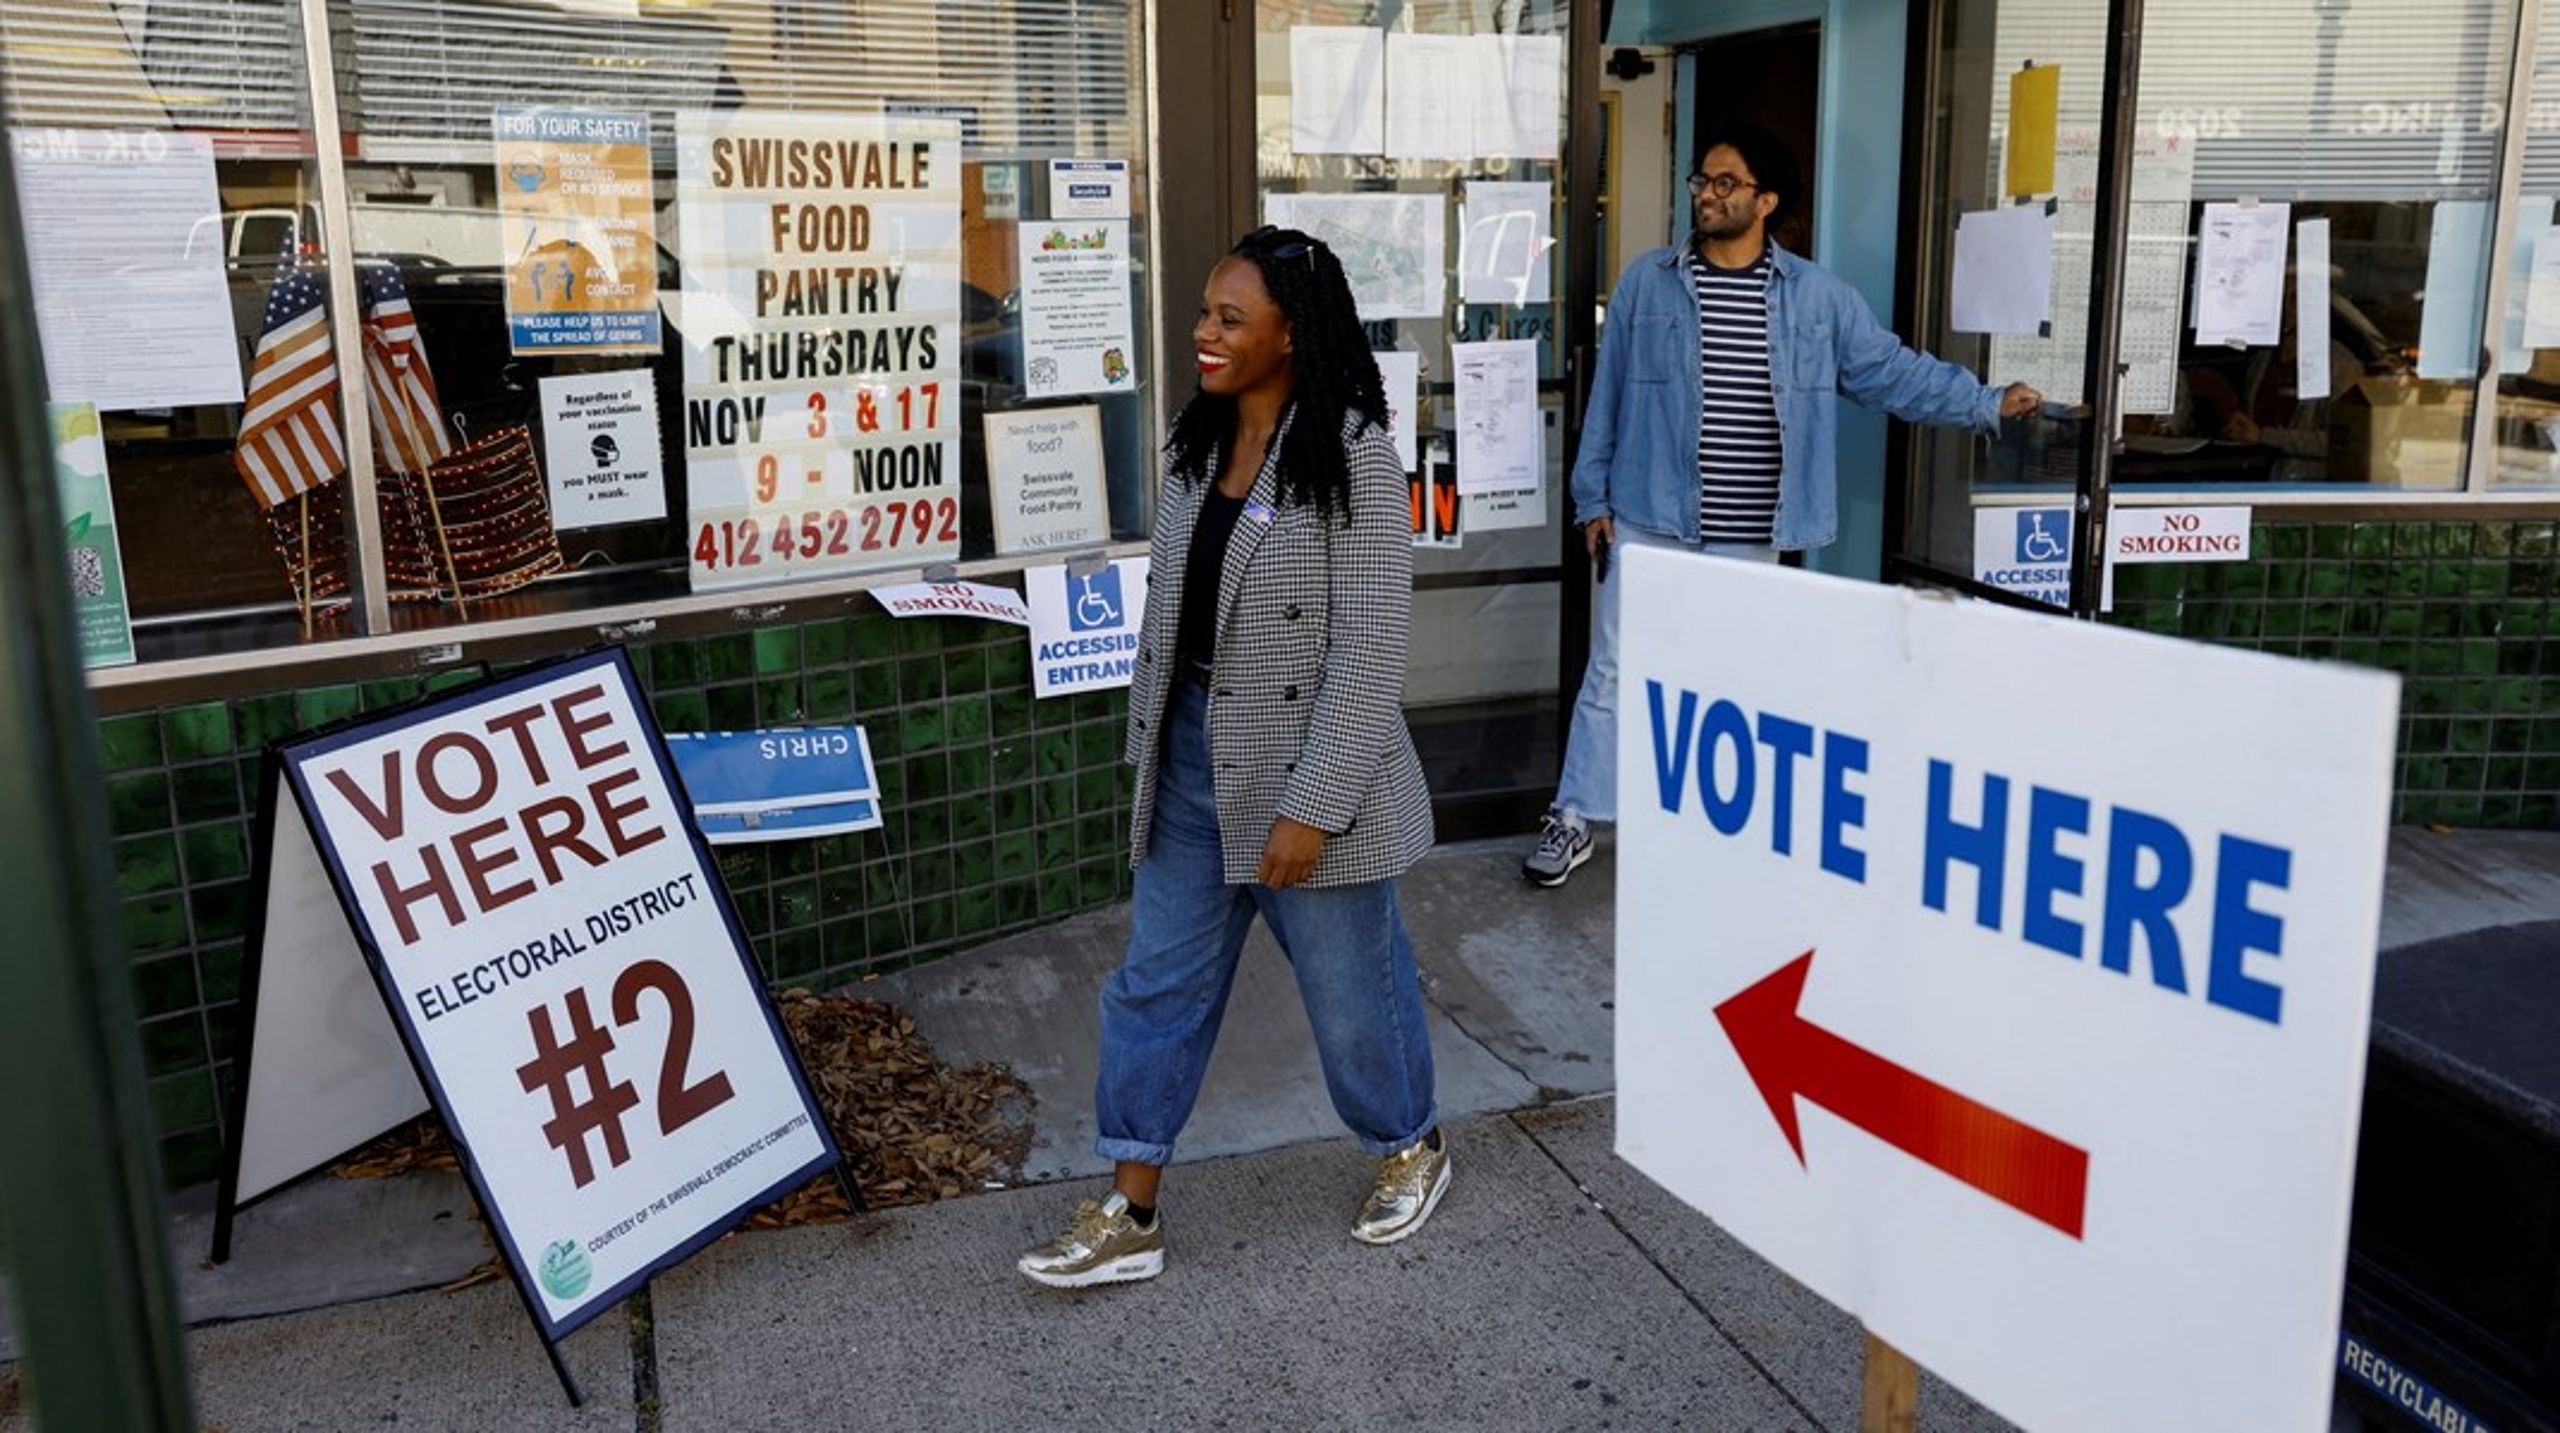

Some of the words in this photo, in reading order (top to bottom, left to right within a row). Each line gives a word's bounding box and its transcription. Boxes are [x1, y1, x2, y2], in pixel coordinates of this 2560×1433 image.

[504, 116, 536, 135] FOR
[539, 117, 582, 137] YOUR
[585, 118, 641, 139] SAFETY
[711, 137, 930, 190] SWISSVALE
[771, 203, 871, 254] FOOD
[585, 282, 637, 298] CONTACT
[756, 266, 904, 318] PANTRY
[523, 315, 561, 330] PLEASE
[564, 314, 590, 329] HELP
[591, 314, 604, 328] US
[606, 314, 619, 327] TO
[531, 331, 551, 344] THE
[552, 330, 592, 344] SPREAD
[593, 330, 607, 343] OF
[607, 328, 643, 342] GERMS
[712, 324, 938, 383] THURSDAYS
[565, 391, 618, 406] Regardless
[621, 389, 633, 400] of
[558, 410, 583, 421] your
[586, 404, 643, 417] vaccination
[689, 396, 766, 448] NOV
[807, 391, 828, 439] 3
[856, 389, 879, 433] &
[897, 382, 939, 432] 17
[588, 420, 618, 431] status
[1008, 423, 1035, 436] Need
[1036, 421, 1058, 438] help
[1059, 419, 1079, 434] with
[1027, 437, 1064, 454] food?
[562, 478, 584, 491] you
[587, 471, 621, 485] MUST
[624, 471, 649, 481] wear
[757, 454, 778, 504] 9
[806, 469, 823, 484] -
[852, 442, 943, 495] NOON
[1023, 470, 1075, 486] Swissvale
[1020, 485, 1080, 502] Community
[1020, 502, 1047, 516] Food
[1049, 499, 1083, 516] Pantry
[694, 518, 762, 570] 412
[772, 509, 850, 561] 452
[860, 496, 959, 552] 2792
[2163, 514, 2200, 532] NO
[1021, 534, 1047, 548] ASK
[2119, 535, 2242, 554] SMOKING
[1983, 568, 2071, 586] ACCESSI
[931, 584, 975, 598] NO
[891, 599, 1029, 621] SMOKING
[1038, 632, 1138, 662] ACCESSIB
[760, 735, 849, 761] CHRIS
[325, 683, 630, 842] VOTE
[371, 768, 667, 947] HERE
[1646, 678, 1870, 885] VOTE
[1920, 757, 2293, 1027] HERE
[416, 926, 586, 1022] ELECTORAL
[586, 873, 699, 945] DISTRICT
[515, 958, 736, 1190] #2
[587, 1217, 637, 1254] COURTESY
[637, 1207, 649, 1225] OF
[649, 1196, 669, 1216] THE
[667, 1168, 715, 1206] SWISSVALE
[714, 1138, 765, 1179] DEMOCRATIC
[764, 1111, 810, 1149] COMMITTEE
